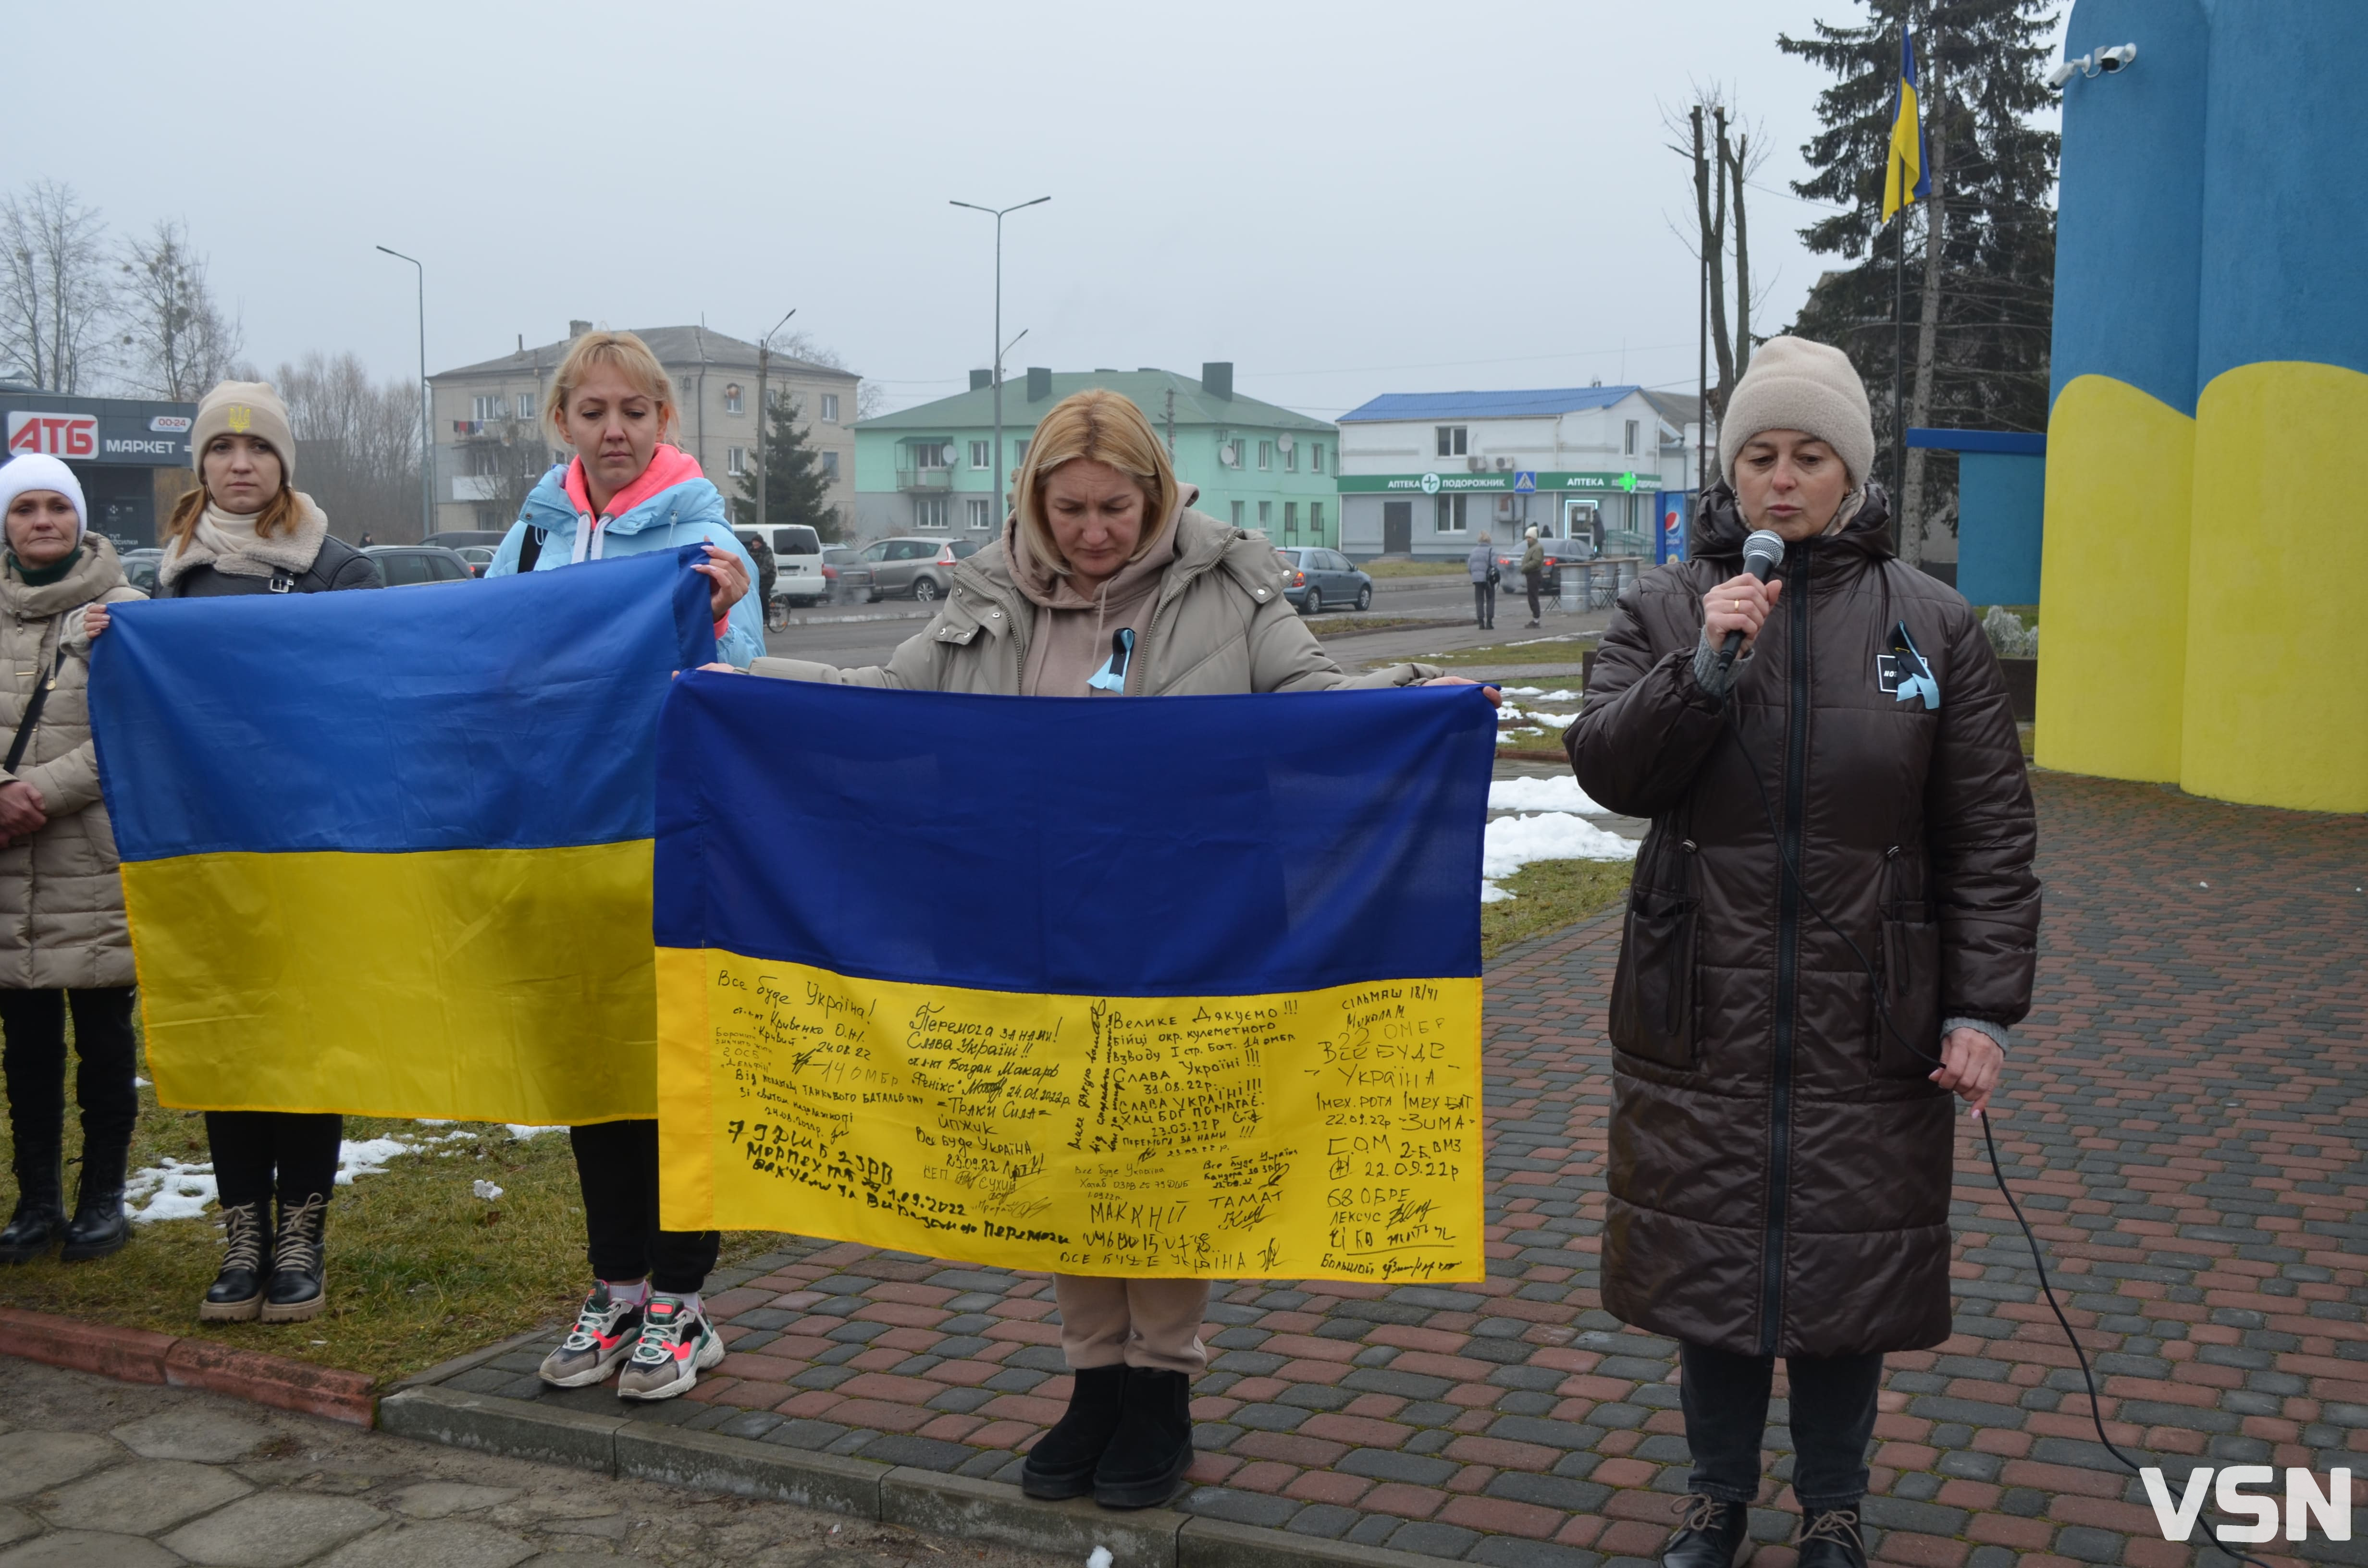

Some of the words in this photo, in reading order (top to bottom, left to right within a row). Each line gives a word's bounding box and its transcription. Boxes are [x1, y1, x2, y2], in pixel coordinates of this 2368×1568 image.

[159, 418, 186, 427] 00-24
[10, 417, 97, 454] АТБ
[106, 440, 175, 454] МАРКЕТ
[1388, 480, 1420, 489] АПТЕКА
[1442, 478, 1505, 488] ПОДОРОЖНИК
[1567, 478, 1604, 487] АПТЕКА
[718, 970, 747, 991] Все
[757, 976, 792, 1008] буде
[770, 1010, 824, 1034] Кривенко
[1187, 1022, 1276, 1043] кулеметного
[948, 1057, 992, 1080] Богдан
